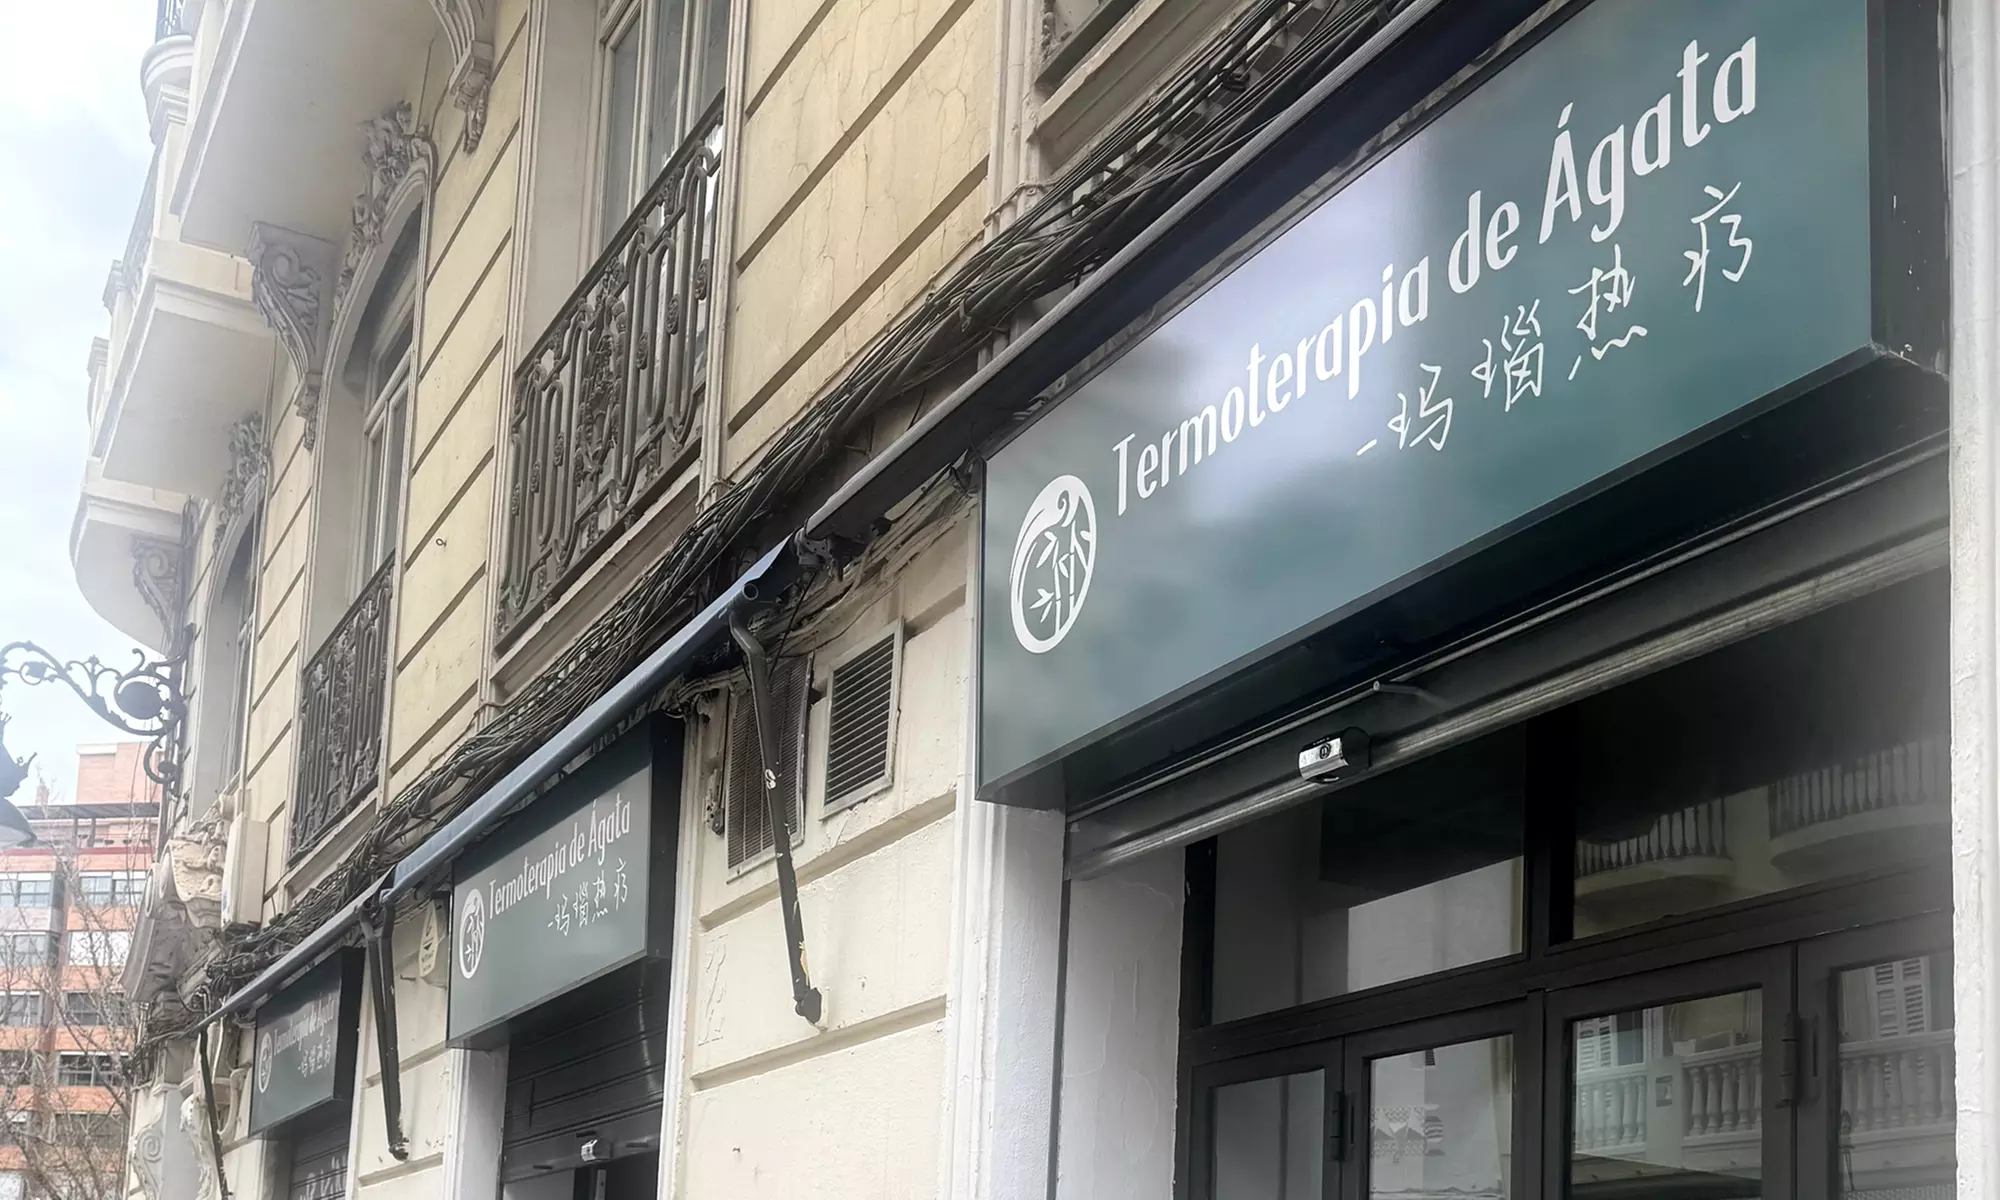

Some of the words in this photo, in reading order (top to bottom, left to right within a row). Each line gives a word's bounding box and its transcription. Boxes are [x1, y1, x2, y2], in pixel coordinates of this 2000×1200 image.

[1112, 256, 1429, 517] Termoterapia
[1448, 190, 1520, 294] de
[1539, 35, 1757, 245] Ágata
[488, 840, 566, 920] Termoterapia
[569, 821, 585, 867] de
[588, 792, 631, 866] Ágata
